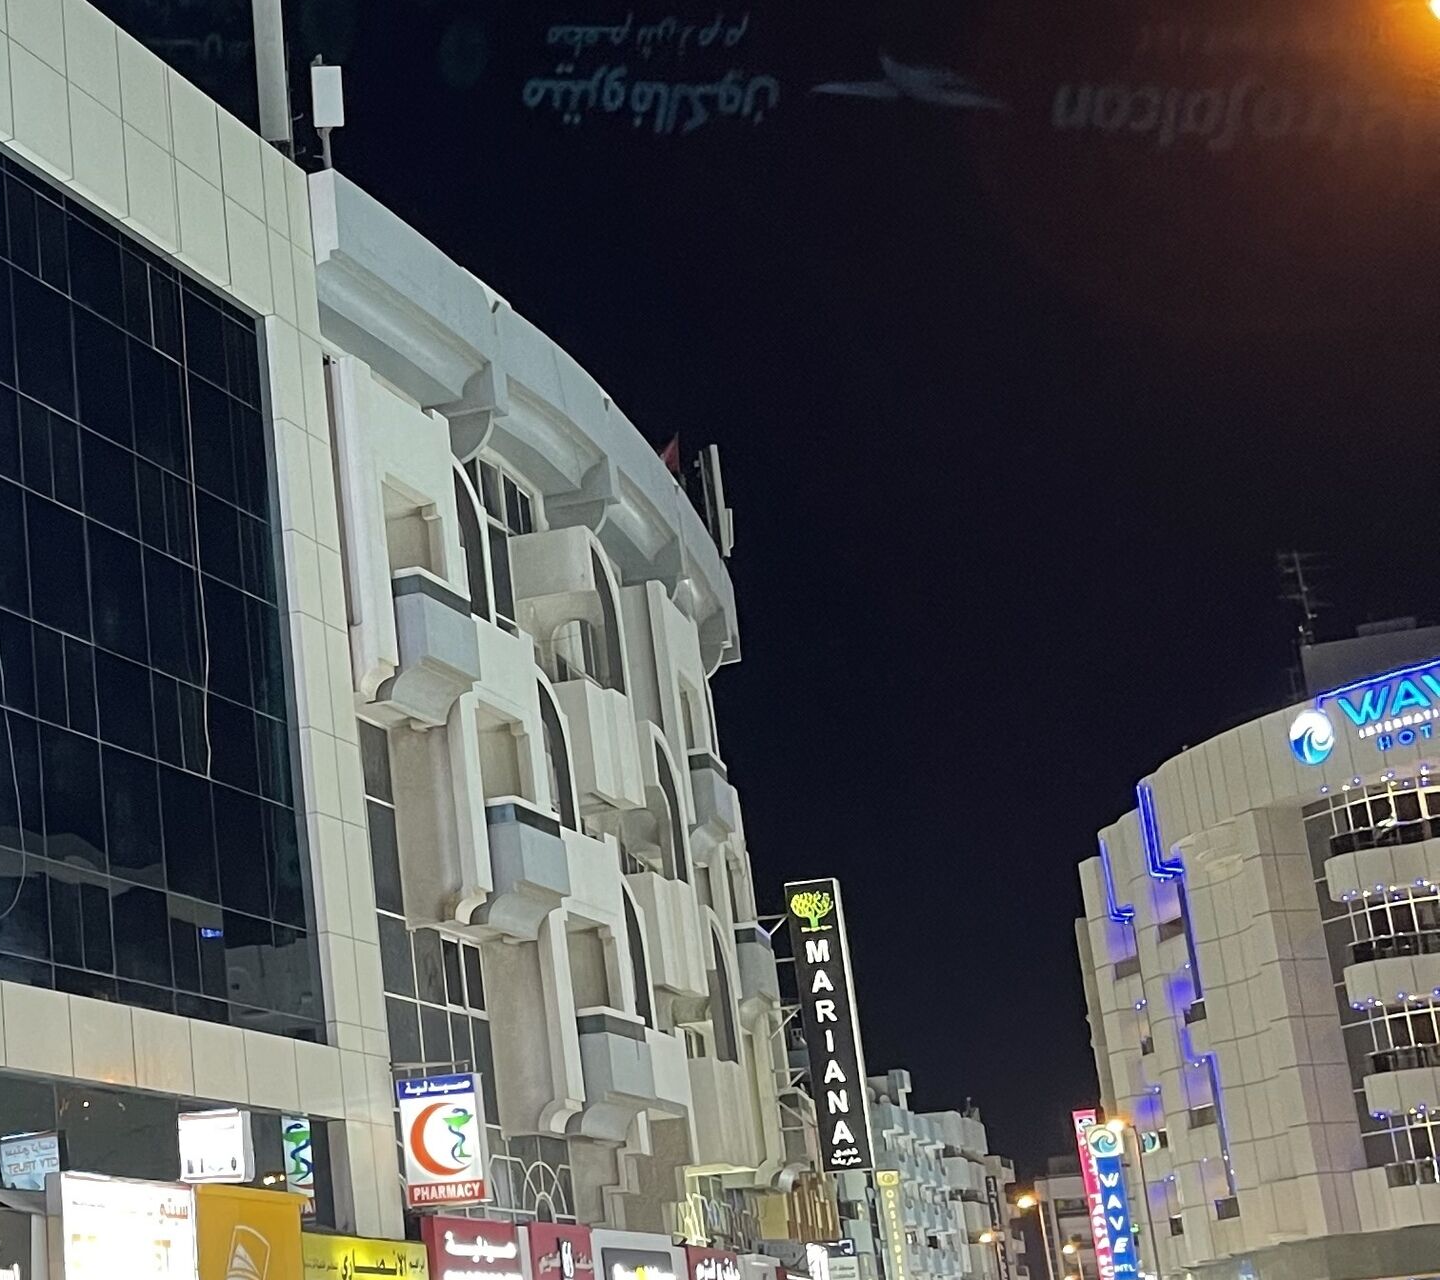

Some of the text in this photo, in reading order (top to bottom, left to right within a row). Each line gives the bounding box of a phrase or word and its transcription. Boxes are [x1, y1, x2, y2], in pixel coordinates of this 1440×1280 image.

[805, 938, 855, 1145] MARIANA
[412, 1184, 481, 1202] PHARMACY
[1100, 1173, 1129, 1254] WAVE
